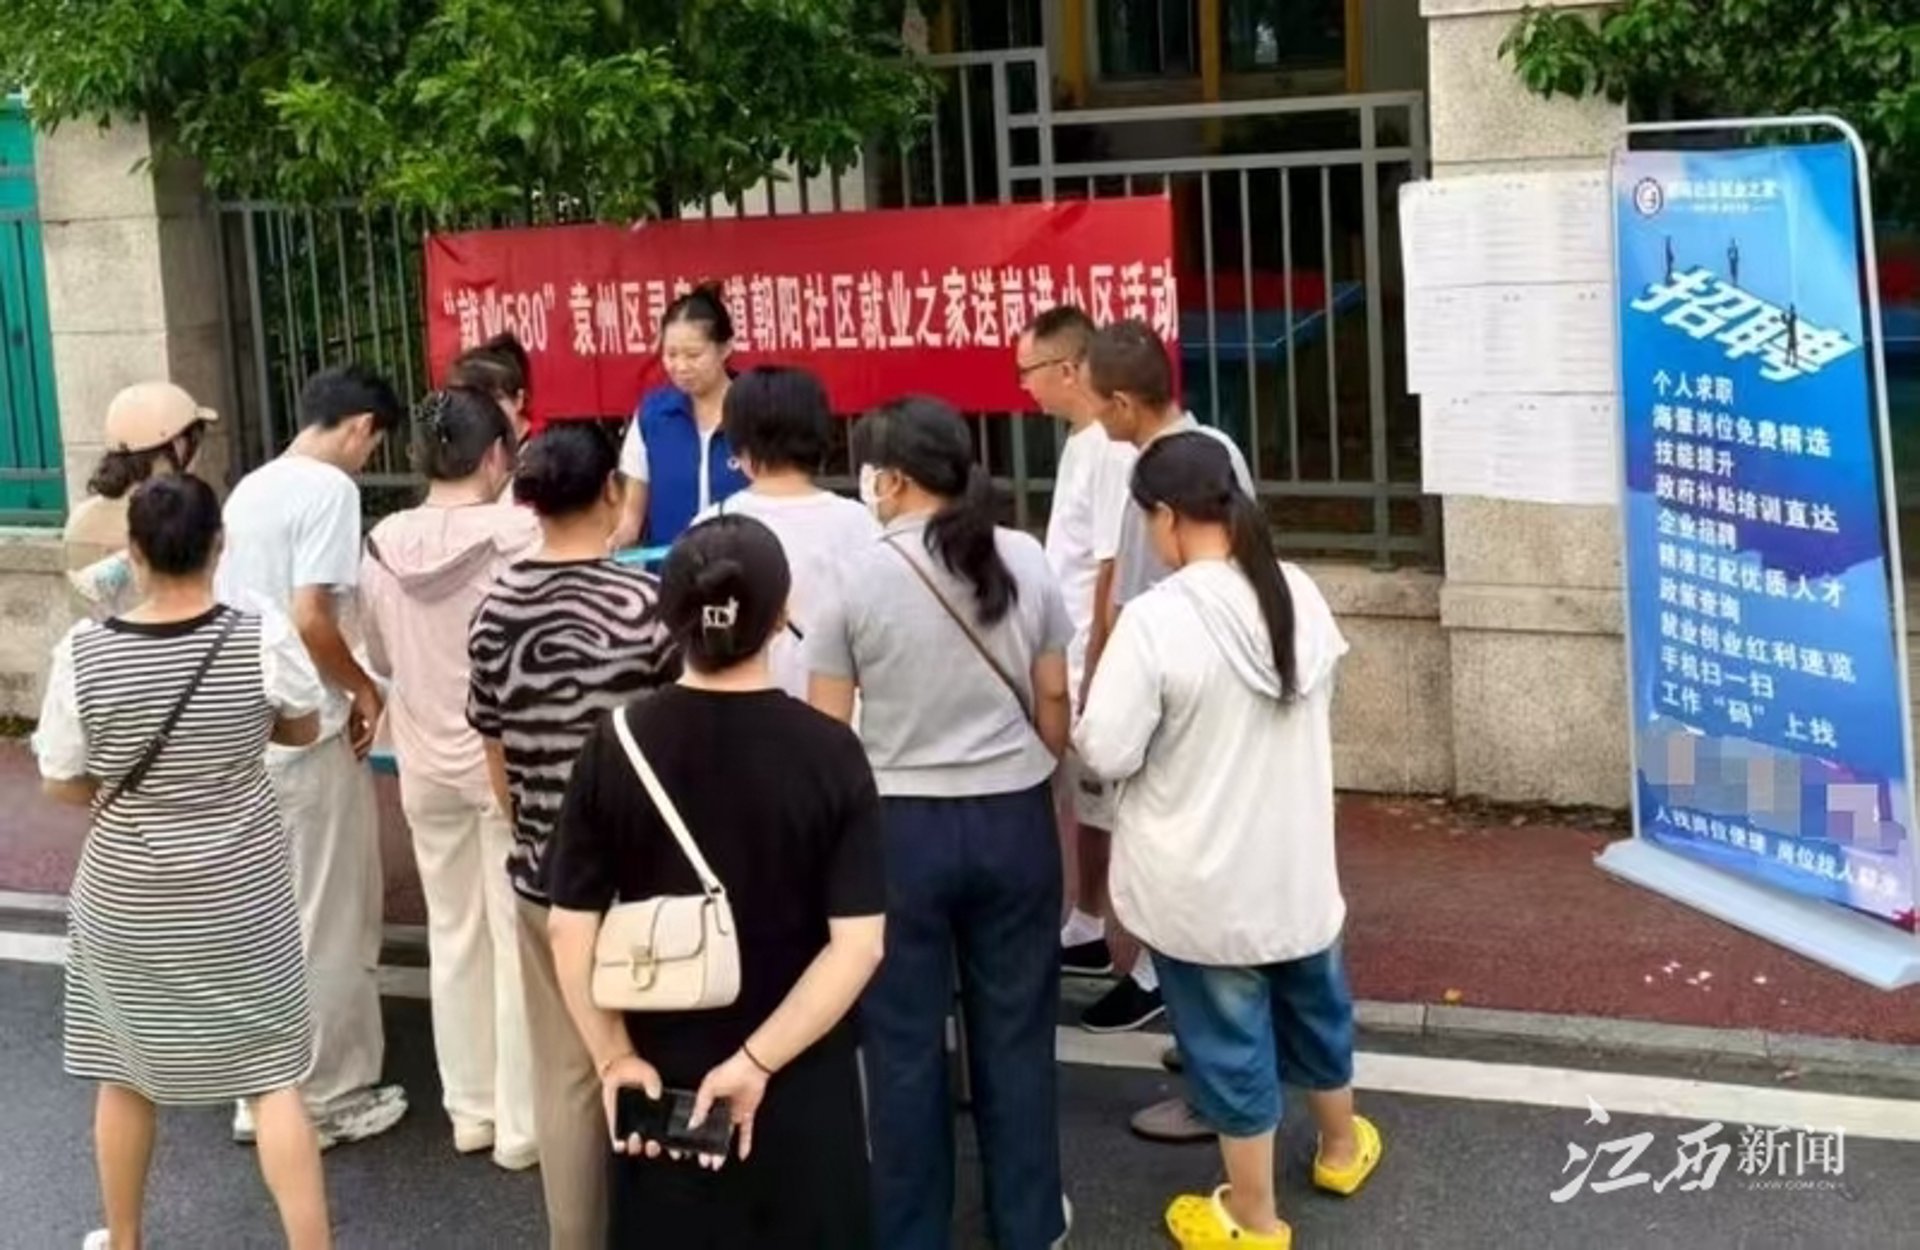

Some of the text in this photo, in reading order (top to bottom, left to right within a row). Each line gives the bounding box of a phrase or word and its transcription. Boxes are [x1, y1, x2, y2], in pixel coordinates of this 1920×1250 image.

[568, 256, 1180, 355] 袁州区灵道朝阳社区就业之家送岗进小区活动
[1630, 266, 1862, 382] 招聘
[1653, 369, 1734, 404] 个人求职
[1652, 404, 1832, 457] 海量岗位免费精选
[1655, 439, 1735, 478] 技能提升
[1655, 474, 1840, 533] 政府补贴培训直达
[1657, 509, 1737, 550] 企业招聘
[1659, 543, 1845, 607] 精准匹配优质人才
[1661, 611, 1857, 683] 就业创业红利速览
[1661, 645, 1774, 698] 手机扫一扫
